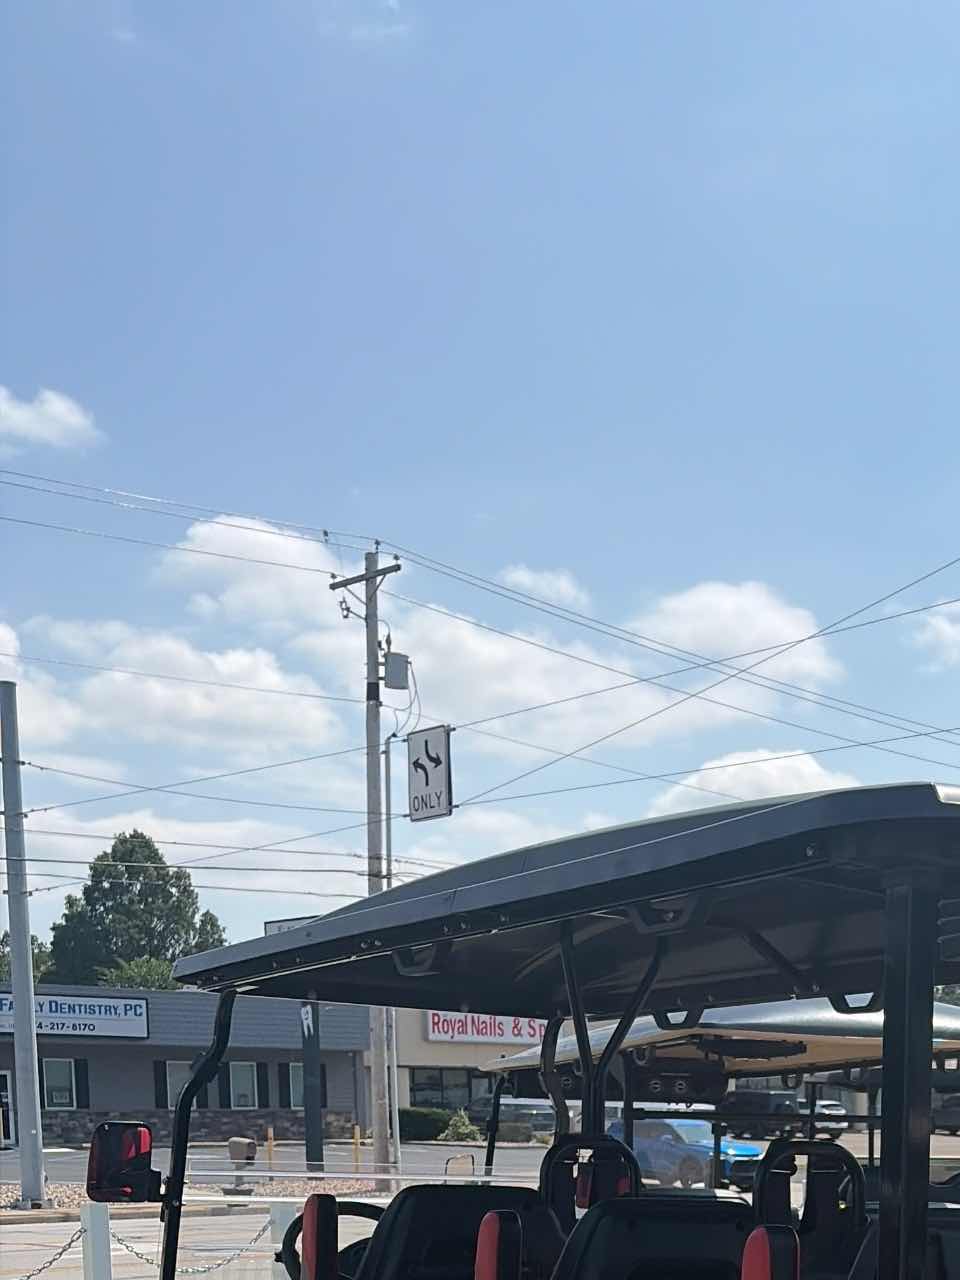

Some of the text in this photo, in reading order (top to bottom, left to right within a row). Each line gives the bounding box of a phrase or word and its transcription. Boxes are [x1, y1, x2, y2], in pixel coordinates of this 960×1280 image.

[413, 791, 442, 812] ONLY
[123, 1003, 143, 1017] PC
[431, 1012, 546, 1039] Royal Nails & Sp
